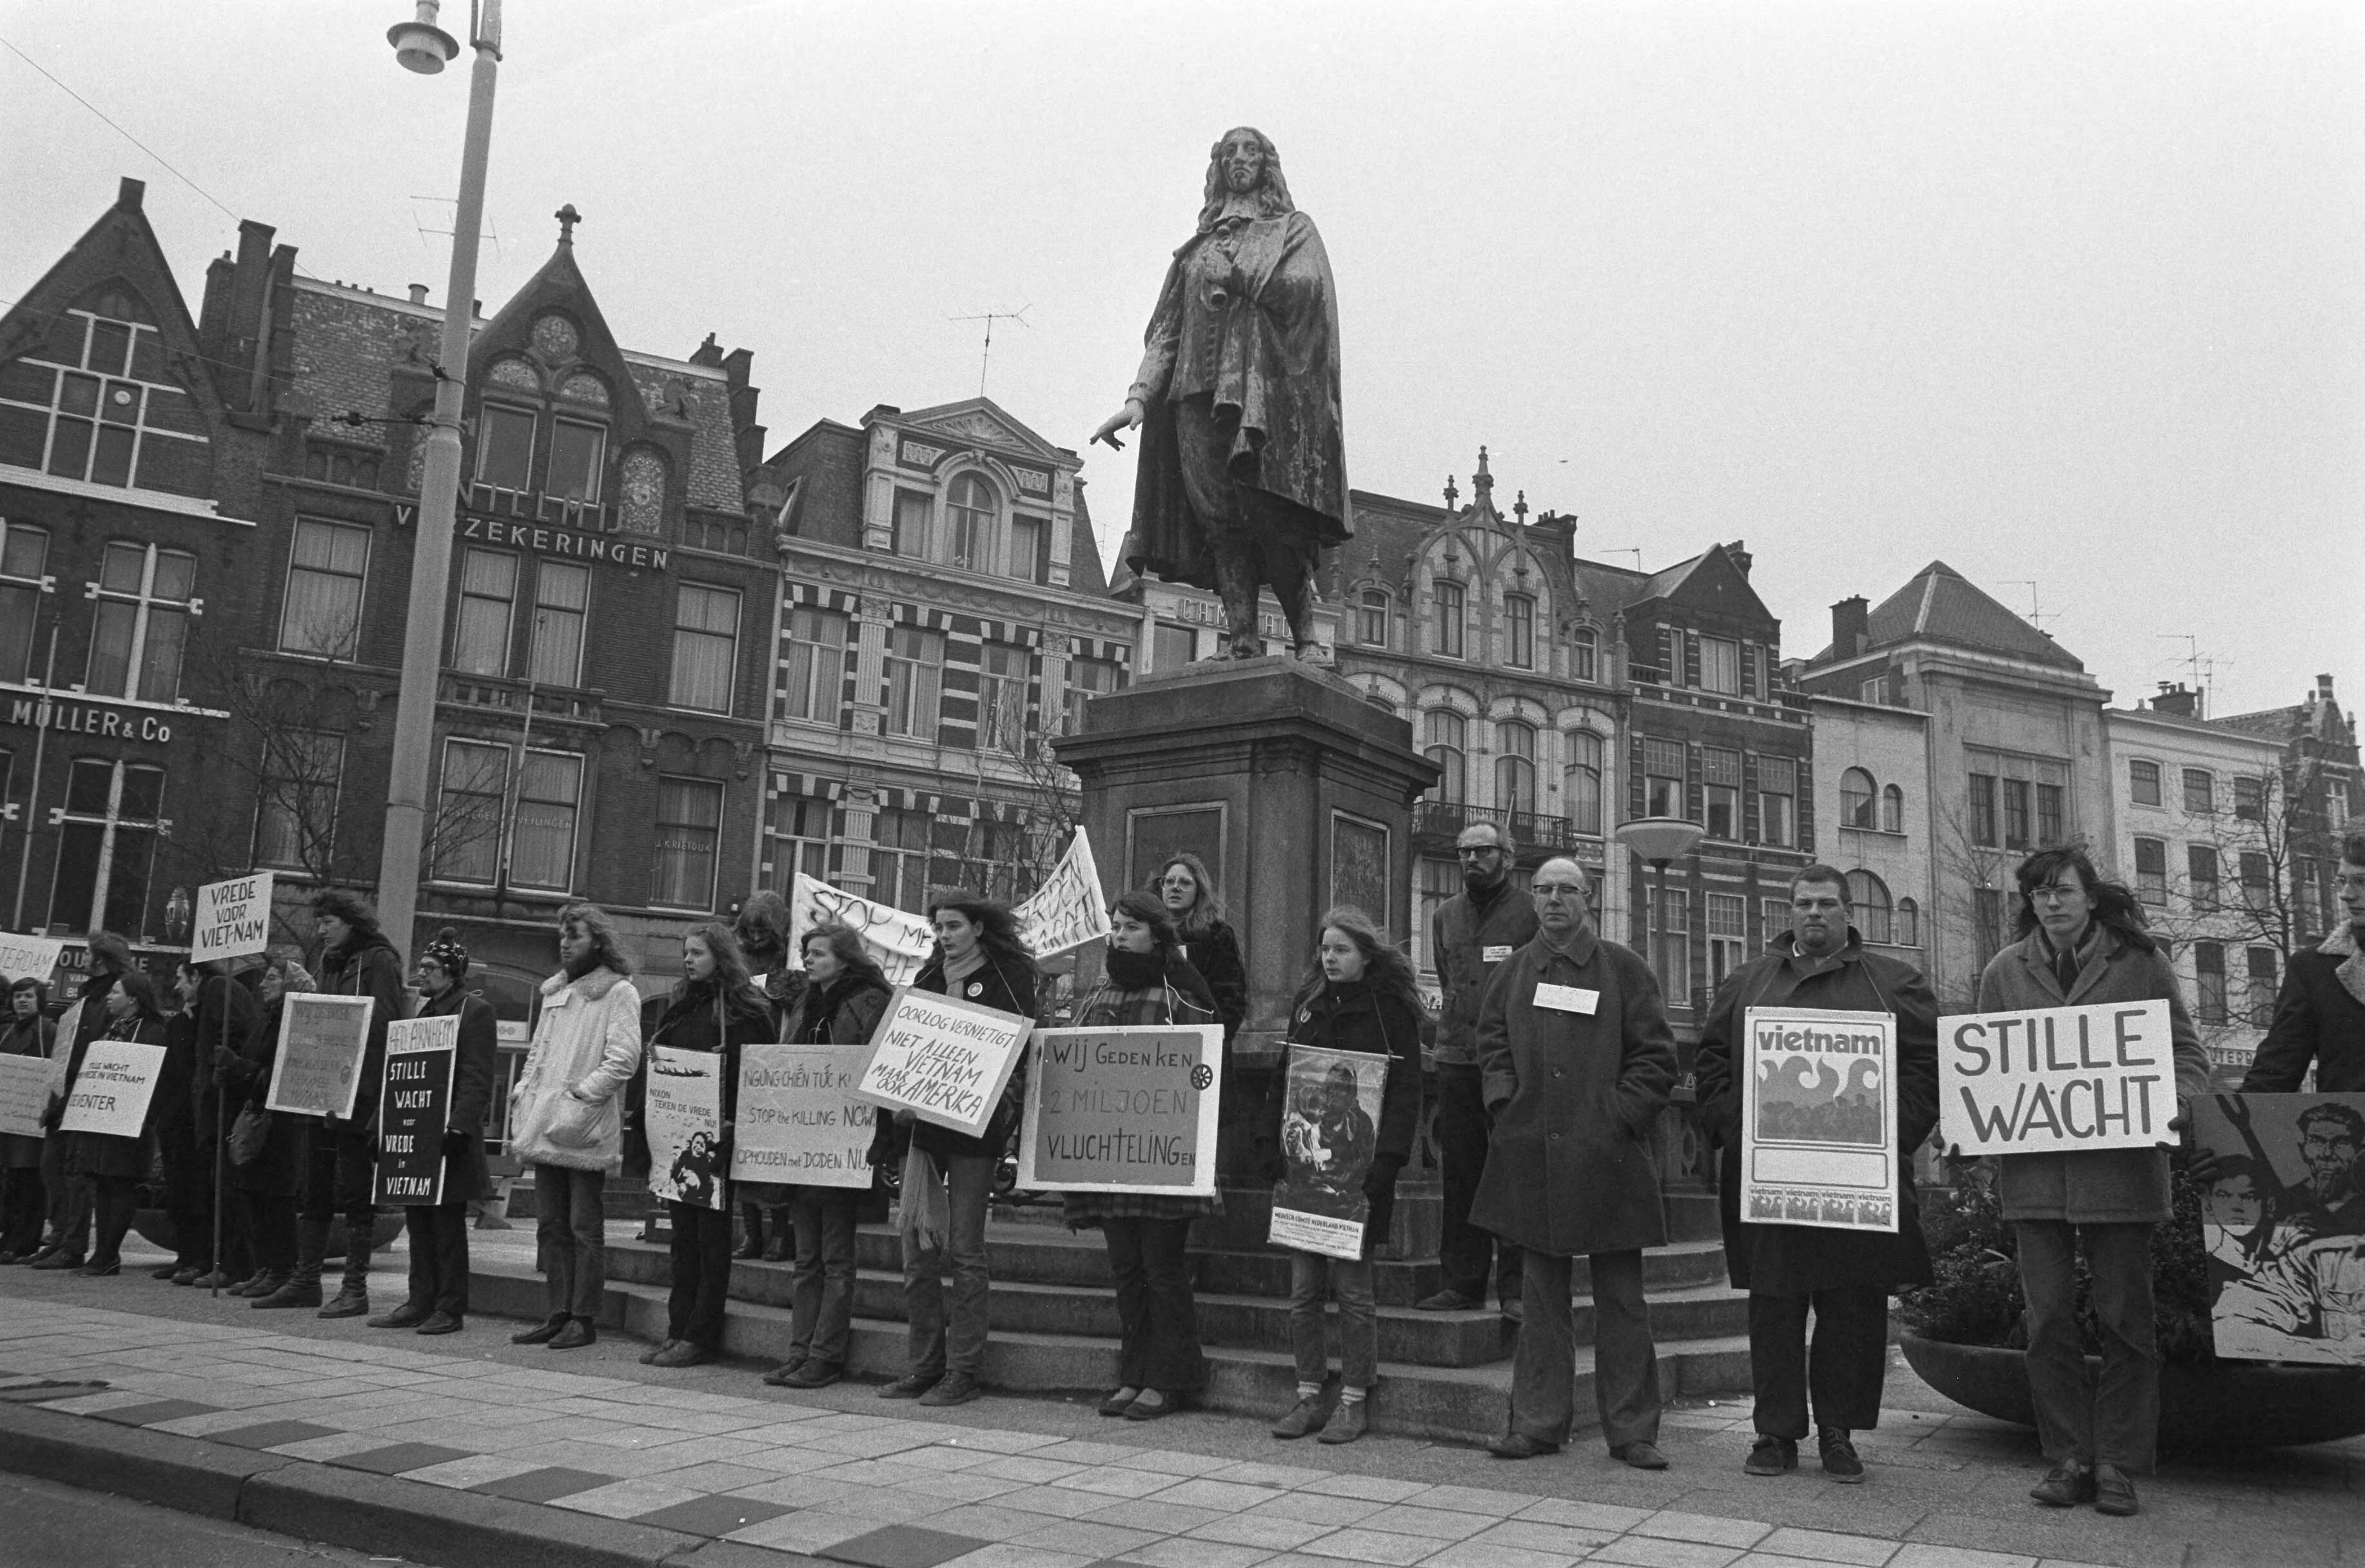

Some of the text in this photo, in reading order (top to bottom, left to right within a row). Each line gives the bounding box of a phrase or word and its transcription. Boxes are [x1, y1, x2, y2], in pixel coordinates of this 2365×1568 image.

[396, 505, 667, 570] VZEKERINGEN
[122, 722, 133, 738] &
[142, 717, 170, 742] Co
[211, 881, 256, 905] VREDE
[217, 904, 246, 923] VOOR
[202, 919, 264, 948] VIET-NAM
[898, 1005, 1016, 1048] OORLOG VERNIETIGT
[885, 1030, 979, 1065] NIET ALLEEN
[1758, 1025, 1881, 1055] vietnam
[1954, 1009, 2155, 1077] STILLE
[389, 1061, 426, 1081] STILLE
[871, 1063, 910, 1083] MAAR
[905, 1051, 984, 1087] VIETNAM
[395, 1090, 432, 1108] WACHT
[649, 1088, 671, 1099] NIXON
[876, 1078, 983, 1117] OOK AMERIKA
[1050, 1090, 1062, 1113] 2
[654, 1099, 712, 1117] TEKEN DE VREDE
[749, 1107, 776, 1124] STOP
[791, 1110, 836, 1126] KILLING
[1959, 1075, 2161, 1143] WACHT
[386, 1135, 415, 1153] VREDE
[736, 1149, 787, 1166] OPHOUDEN
[803, 1152, 843, 1169] DODEN
[387, 1177, 431, 1195] VIETNAM
[1821, 1191, 1854, 1199] vietnam
[1858, 1193, 1891, 1202] vietnam
